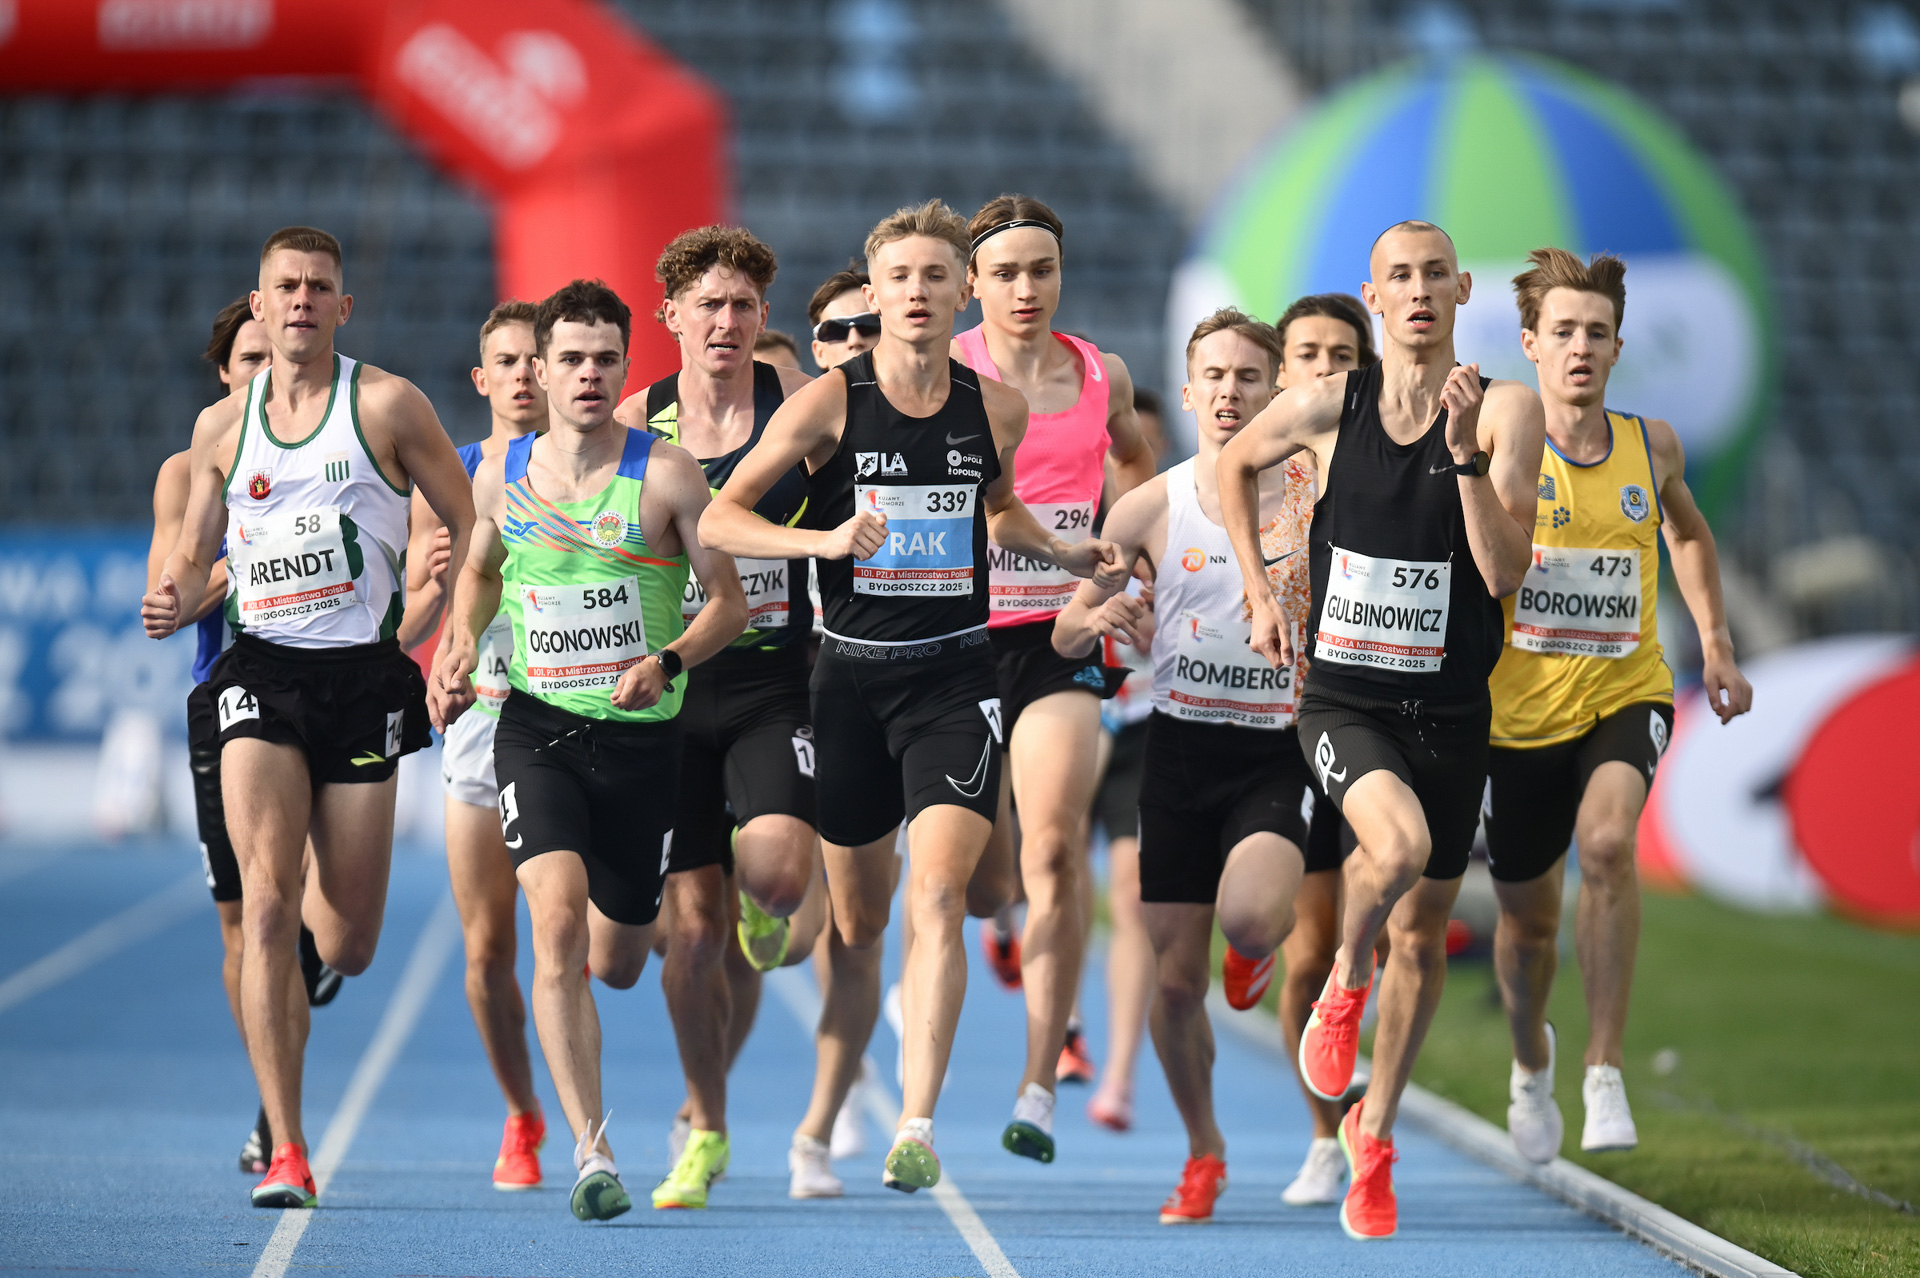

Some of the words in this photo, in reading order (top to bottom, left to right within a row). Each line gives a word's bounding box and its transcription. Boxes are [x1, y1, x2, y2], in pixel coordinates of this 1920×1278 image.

[881, 452, 908, 471] LA
[962, 456, 982, 464] OPOLE
[926, 491, 967, 512] 339
[294, 514, 321, 536] 58
[1054, 508, 1089, 529] 296
[890, 531, 947, 556] RAK
[251, 549, 334, 586] ARENDT
[861, 569, 874, 577] 101.
[950, 570, 969, 578] Polski
[1590, 556, 1632, 577] 473
[869, 582, 938, 591] BYDGOSZCZ
[939, 583, 962, 592] 2025
[1392, 567, 1439, 590] 576
[273, 590, 321, 606] Mistrzostwa
[322, 584, 348, 597] Polski
[583, 585, 628, 610] 584
[998, 597, 1060, 607] BYDGOSZCZ
[1520, 586, 1636, 618] BOROWSKI
[254, 604, 312, 621] BYDGOSZCZ
[314, 598, 340, 611] 2025
[1328, 595, 1442, 632] GULBINOWICZ
[530, 620, 641, 654] OGONOWSKI
[836, 640, 889, 660] NIKE
[890, 642, 942, 659] PRO
[960, 628, 990, 648] NIK
[1535, 627, 1554, 636] PZLA
[1609, 632, 1633, 640] Polski
[1335, 637, 1354, 648] PZLA
[1356, 642, 1409, 655] Mistrzostwa
[1527, 639, 1594, 652] BYDGOSZCZ
[1597, 645, 1622, 653] 2025
[1327, 649, 1395, 665] BYDGOSZCZ
[1398, 659, 1426, 668] 2025
[547, 668, 564, 676] PZLA
[566, 664, 617, 676] Mistrzostwa
[1177, 654, 1290, 690] ROMBERG
[542, 676, 606, 689] BYDGOSZCZ
[220, 691, 257, 720] 14
[1188, 697, 1208, 706] PZLA
[1209, 699, 1260, 712] Mistrzostwa
[1262, 703, 1286, 712] Polski
[988, 706, 1002, 735] 1
[1180, 707, 1248, 722] BYDGOSZCZ
[1250, 715, 1276, 724] 2025
